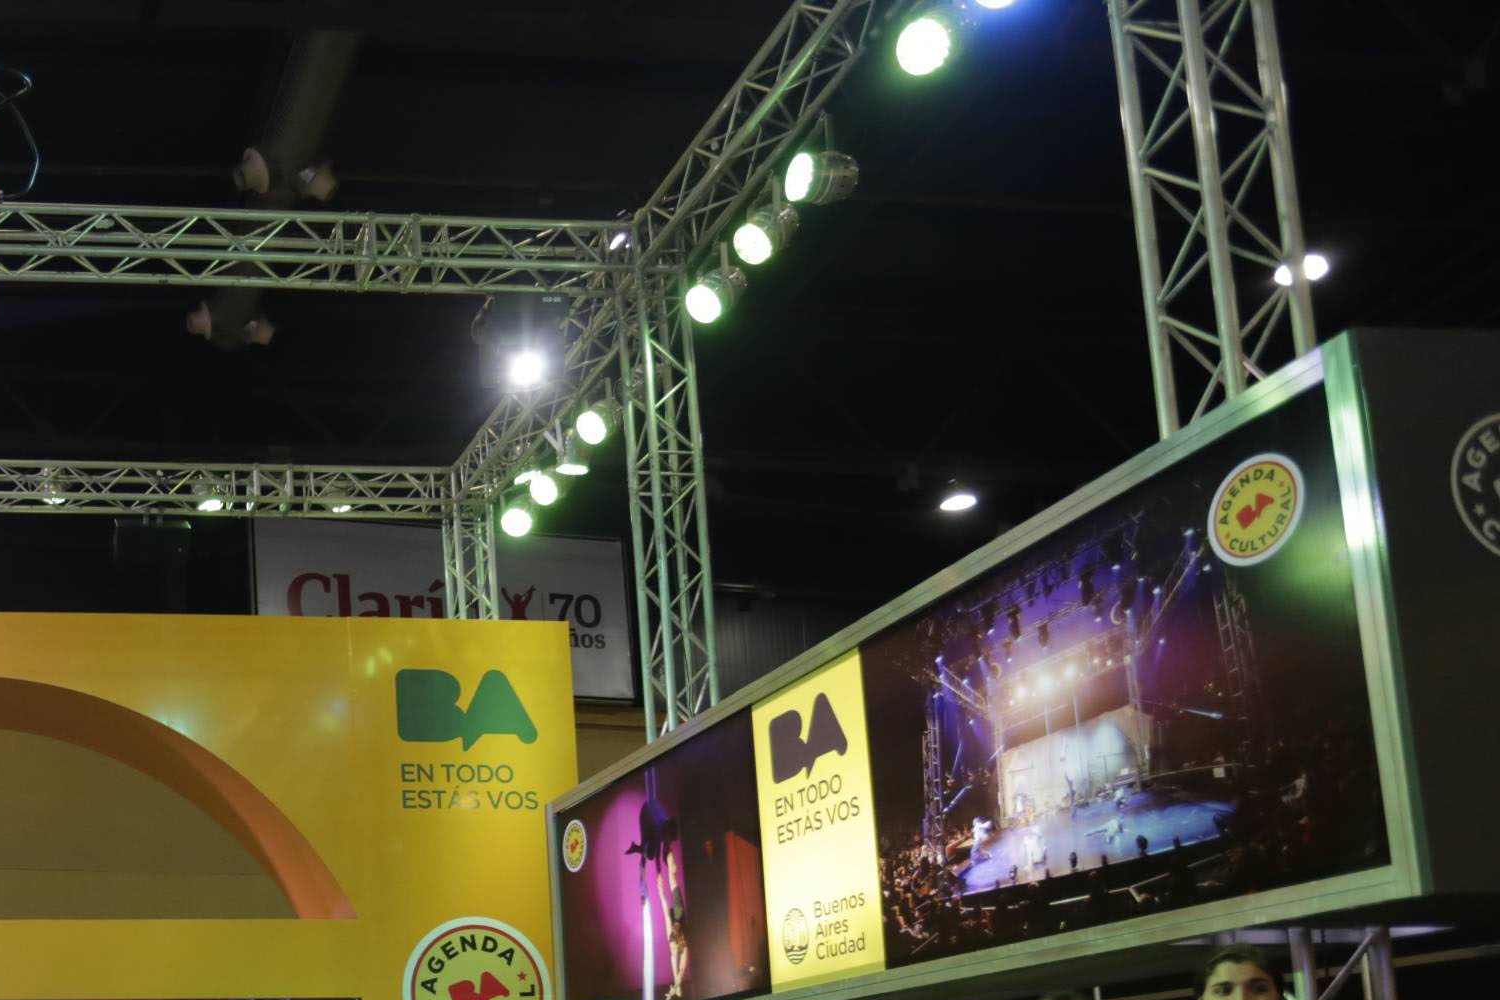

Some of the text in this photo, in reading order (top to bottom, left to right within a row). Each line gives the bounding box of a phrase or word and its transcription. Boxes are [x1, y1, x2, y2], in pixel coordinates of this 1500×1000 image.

[1219, 469, 1275, 525] AGENDA
[1229, 486, 1292, 553] CULTURAL
[549, 593, 602, 628] 70
[401, 763, 514, 783] EN TODO
[402, 785, 539, 810] ESTÁS VOS
[775, 774, 842, 817] EN TODO
[777, 796, 861, 844] ESTÁS VOS
[814, 892, 865, 918] Buenos
[815, 919, 849, 939] Aires
[816, 932, 866, 960] Ciudad
[421, 934, 515, 995] AGENDA
